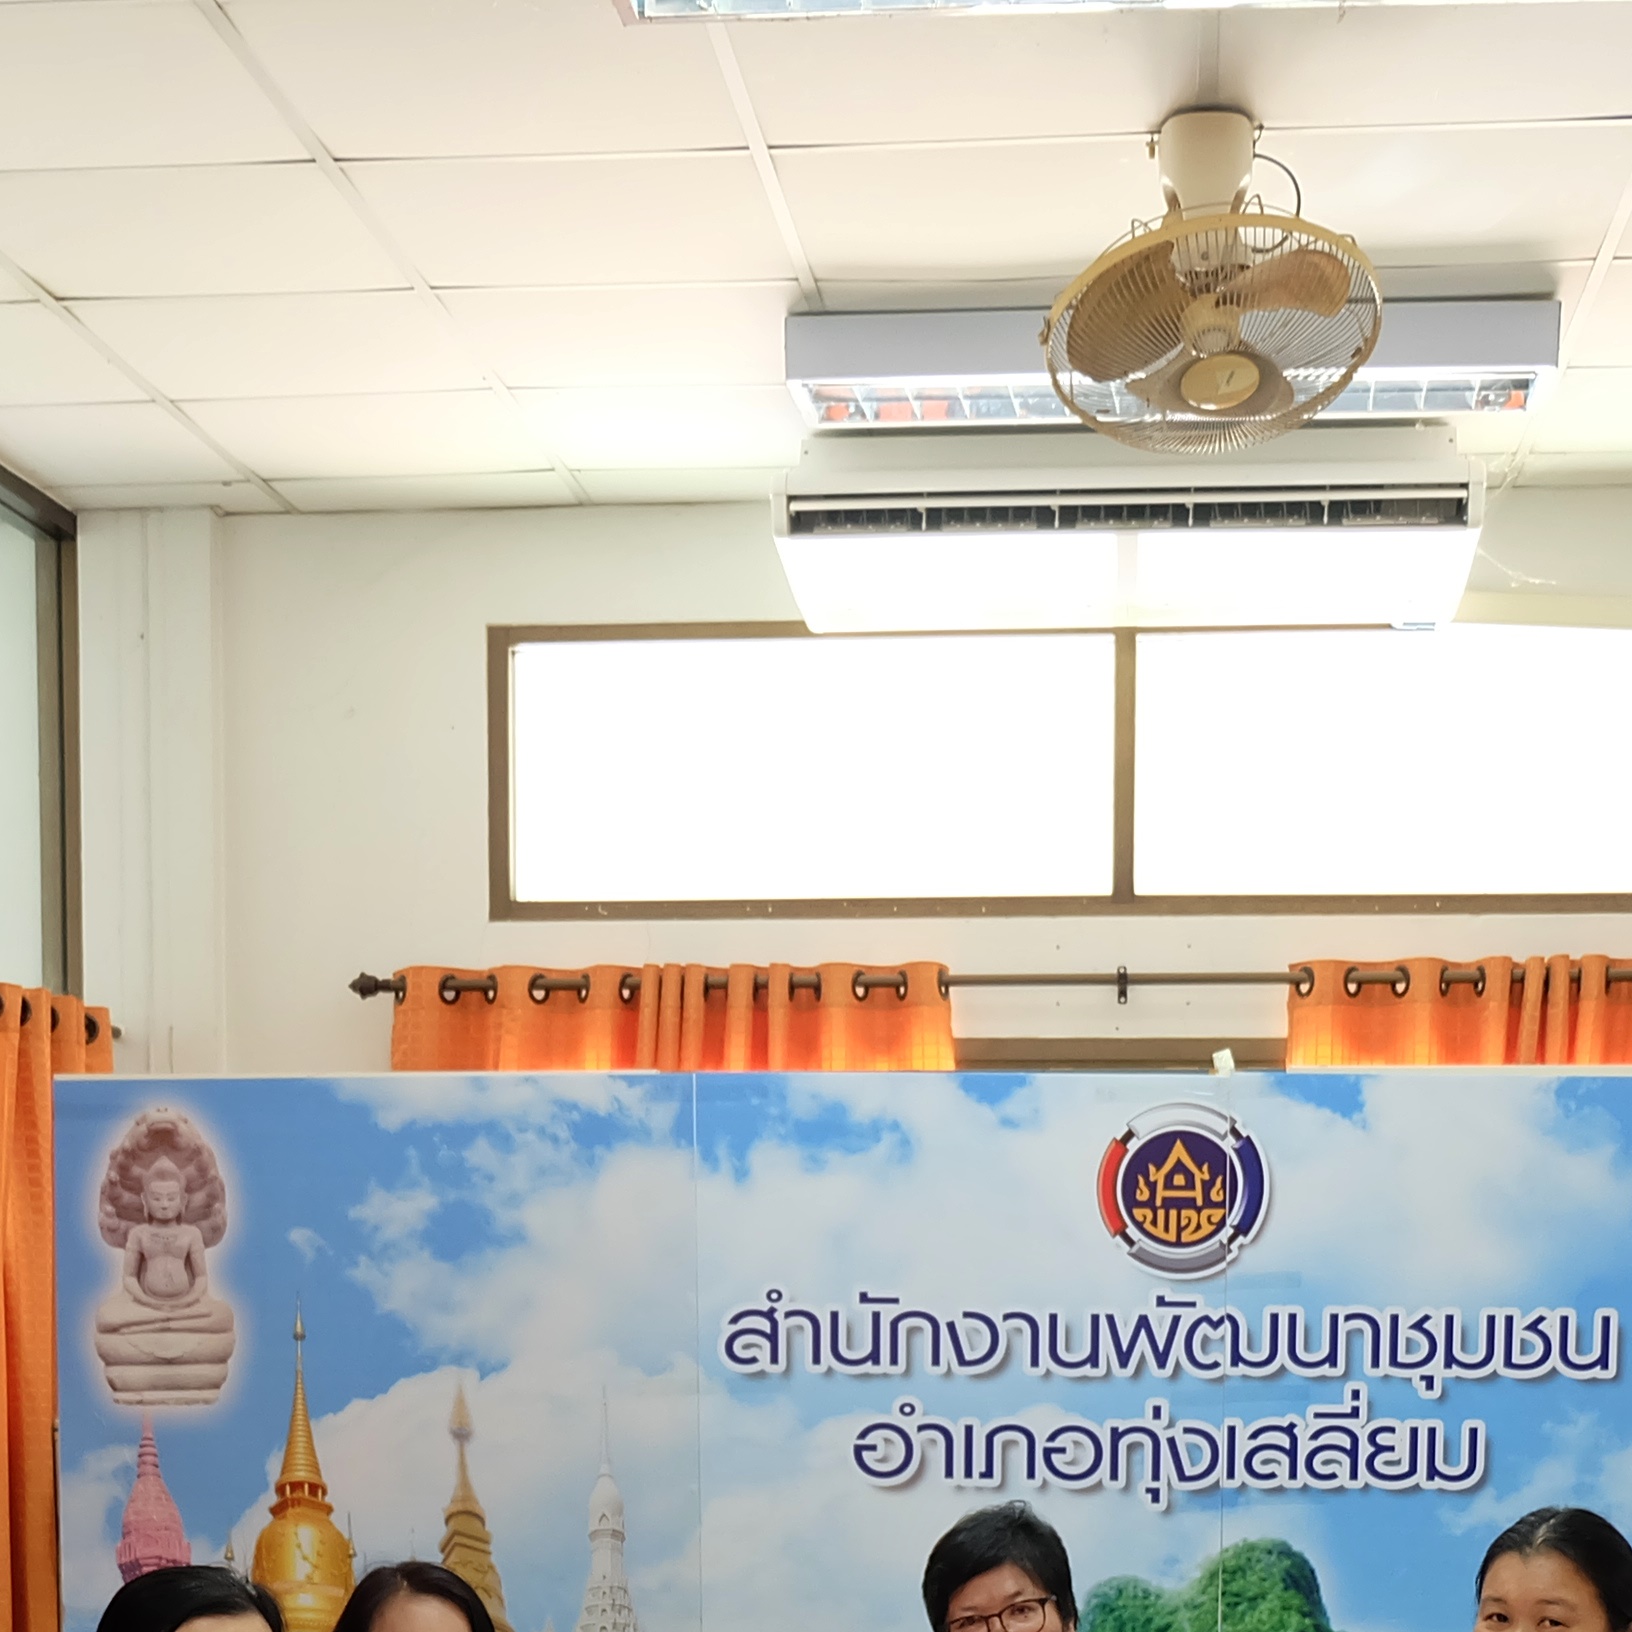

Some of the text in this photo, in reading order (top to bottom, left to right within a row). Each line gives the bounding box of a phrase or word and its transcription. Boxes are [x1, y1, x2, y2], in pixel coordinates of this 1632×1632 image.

[726, 1290, 1617, 1394] สำนักงานพัฒนาชุมชน
[852, 1388, 1483, 1505] อำเภอทุ่งเสลี่ยม
